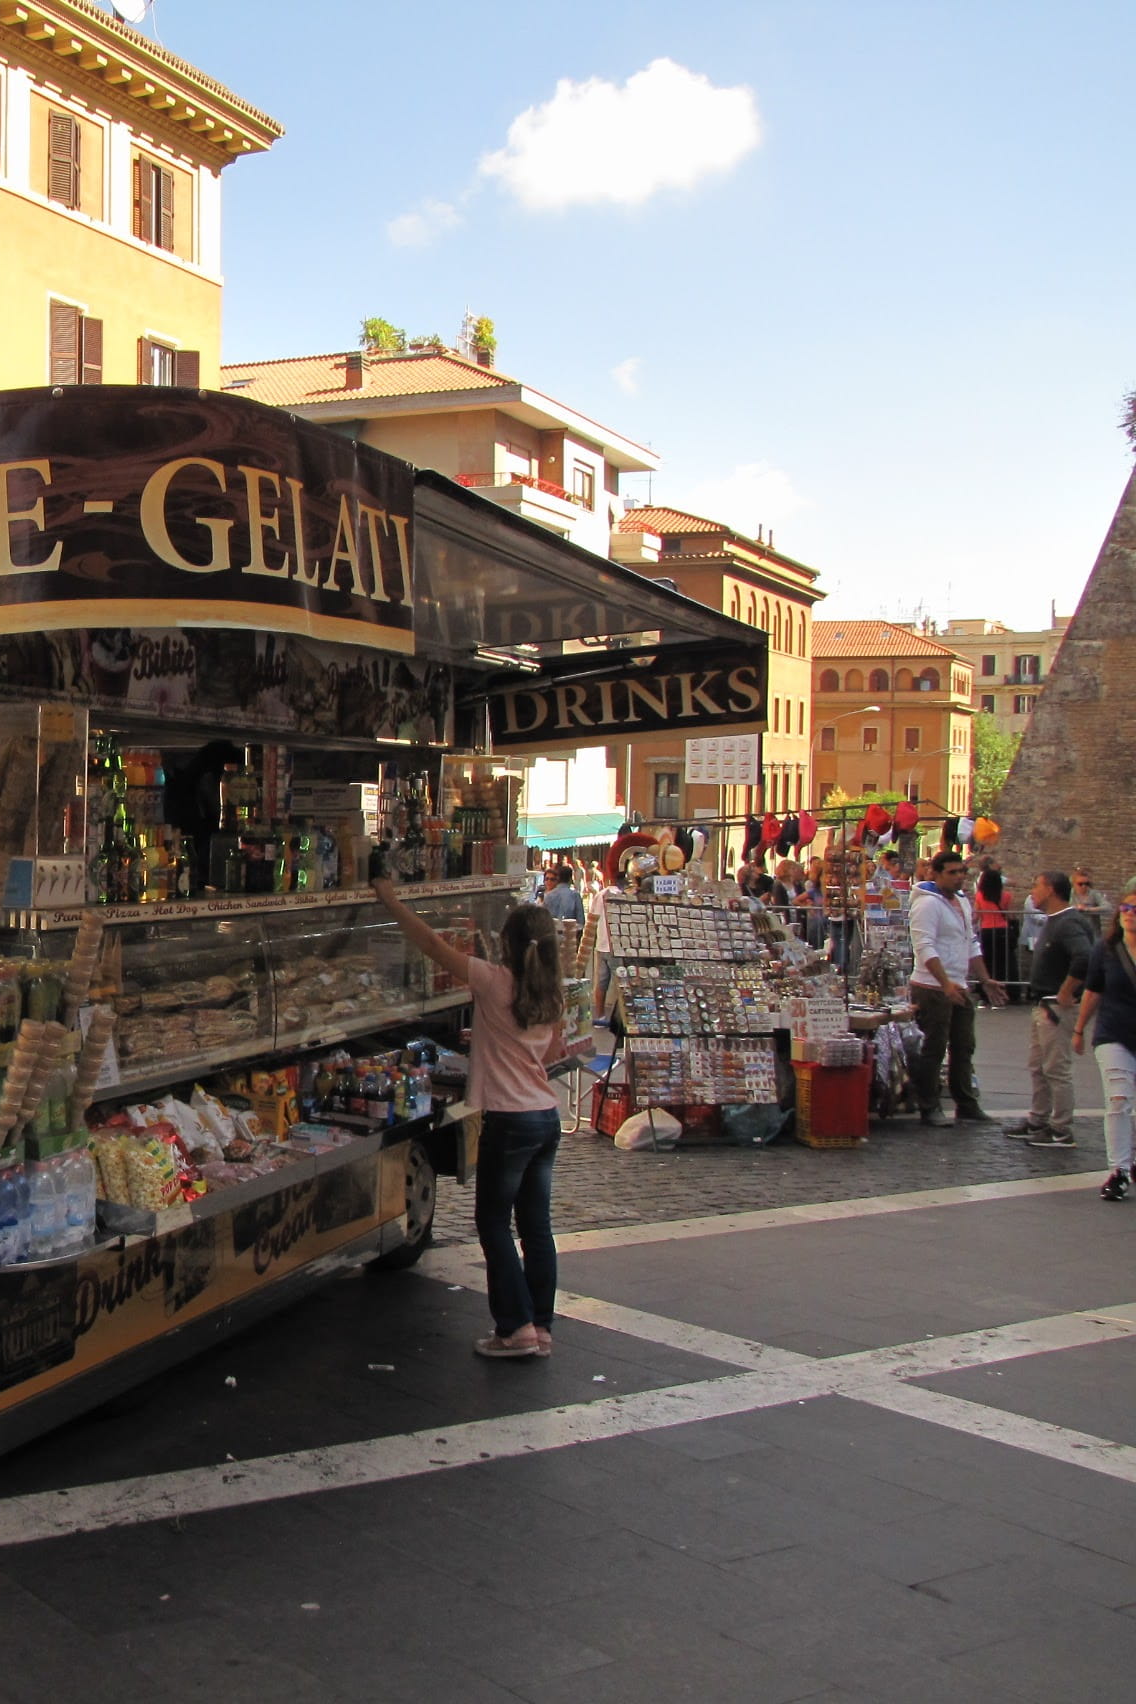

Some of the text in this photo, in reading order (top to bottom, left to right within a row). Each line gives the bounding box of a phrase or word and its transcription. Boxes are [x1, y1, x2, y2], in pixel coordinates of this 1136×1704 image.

[140, 456, 415, 608] GELATI
[132, 635, 194, 680] Bibite
[501, 666, 761, 735] DRINKS
[105, 907, 141, 919] Pizza
[151, 904, 174, 916] Hot
[176, 903, 198, 917] Dog
[207, 899, 243, 912] Chicken
[245, 896, 287, 909] Sandwich
